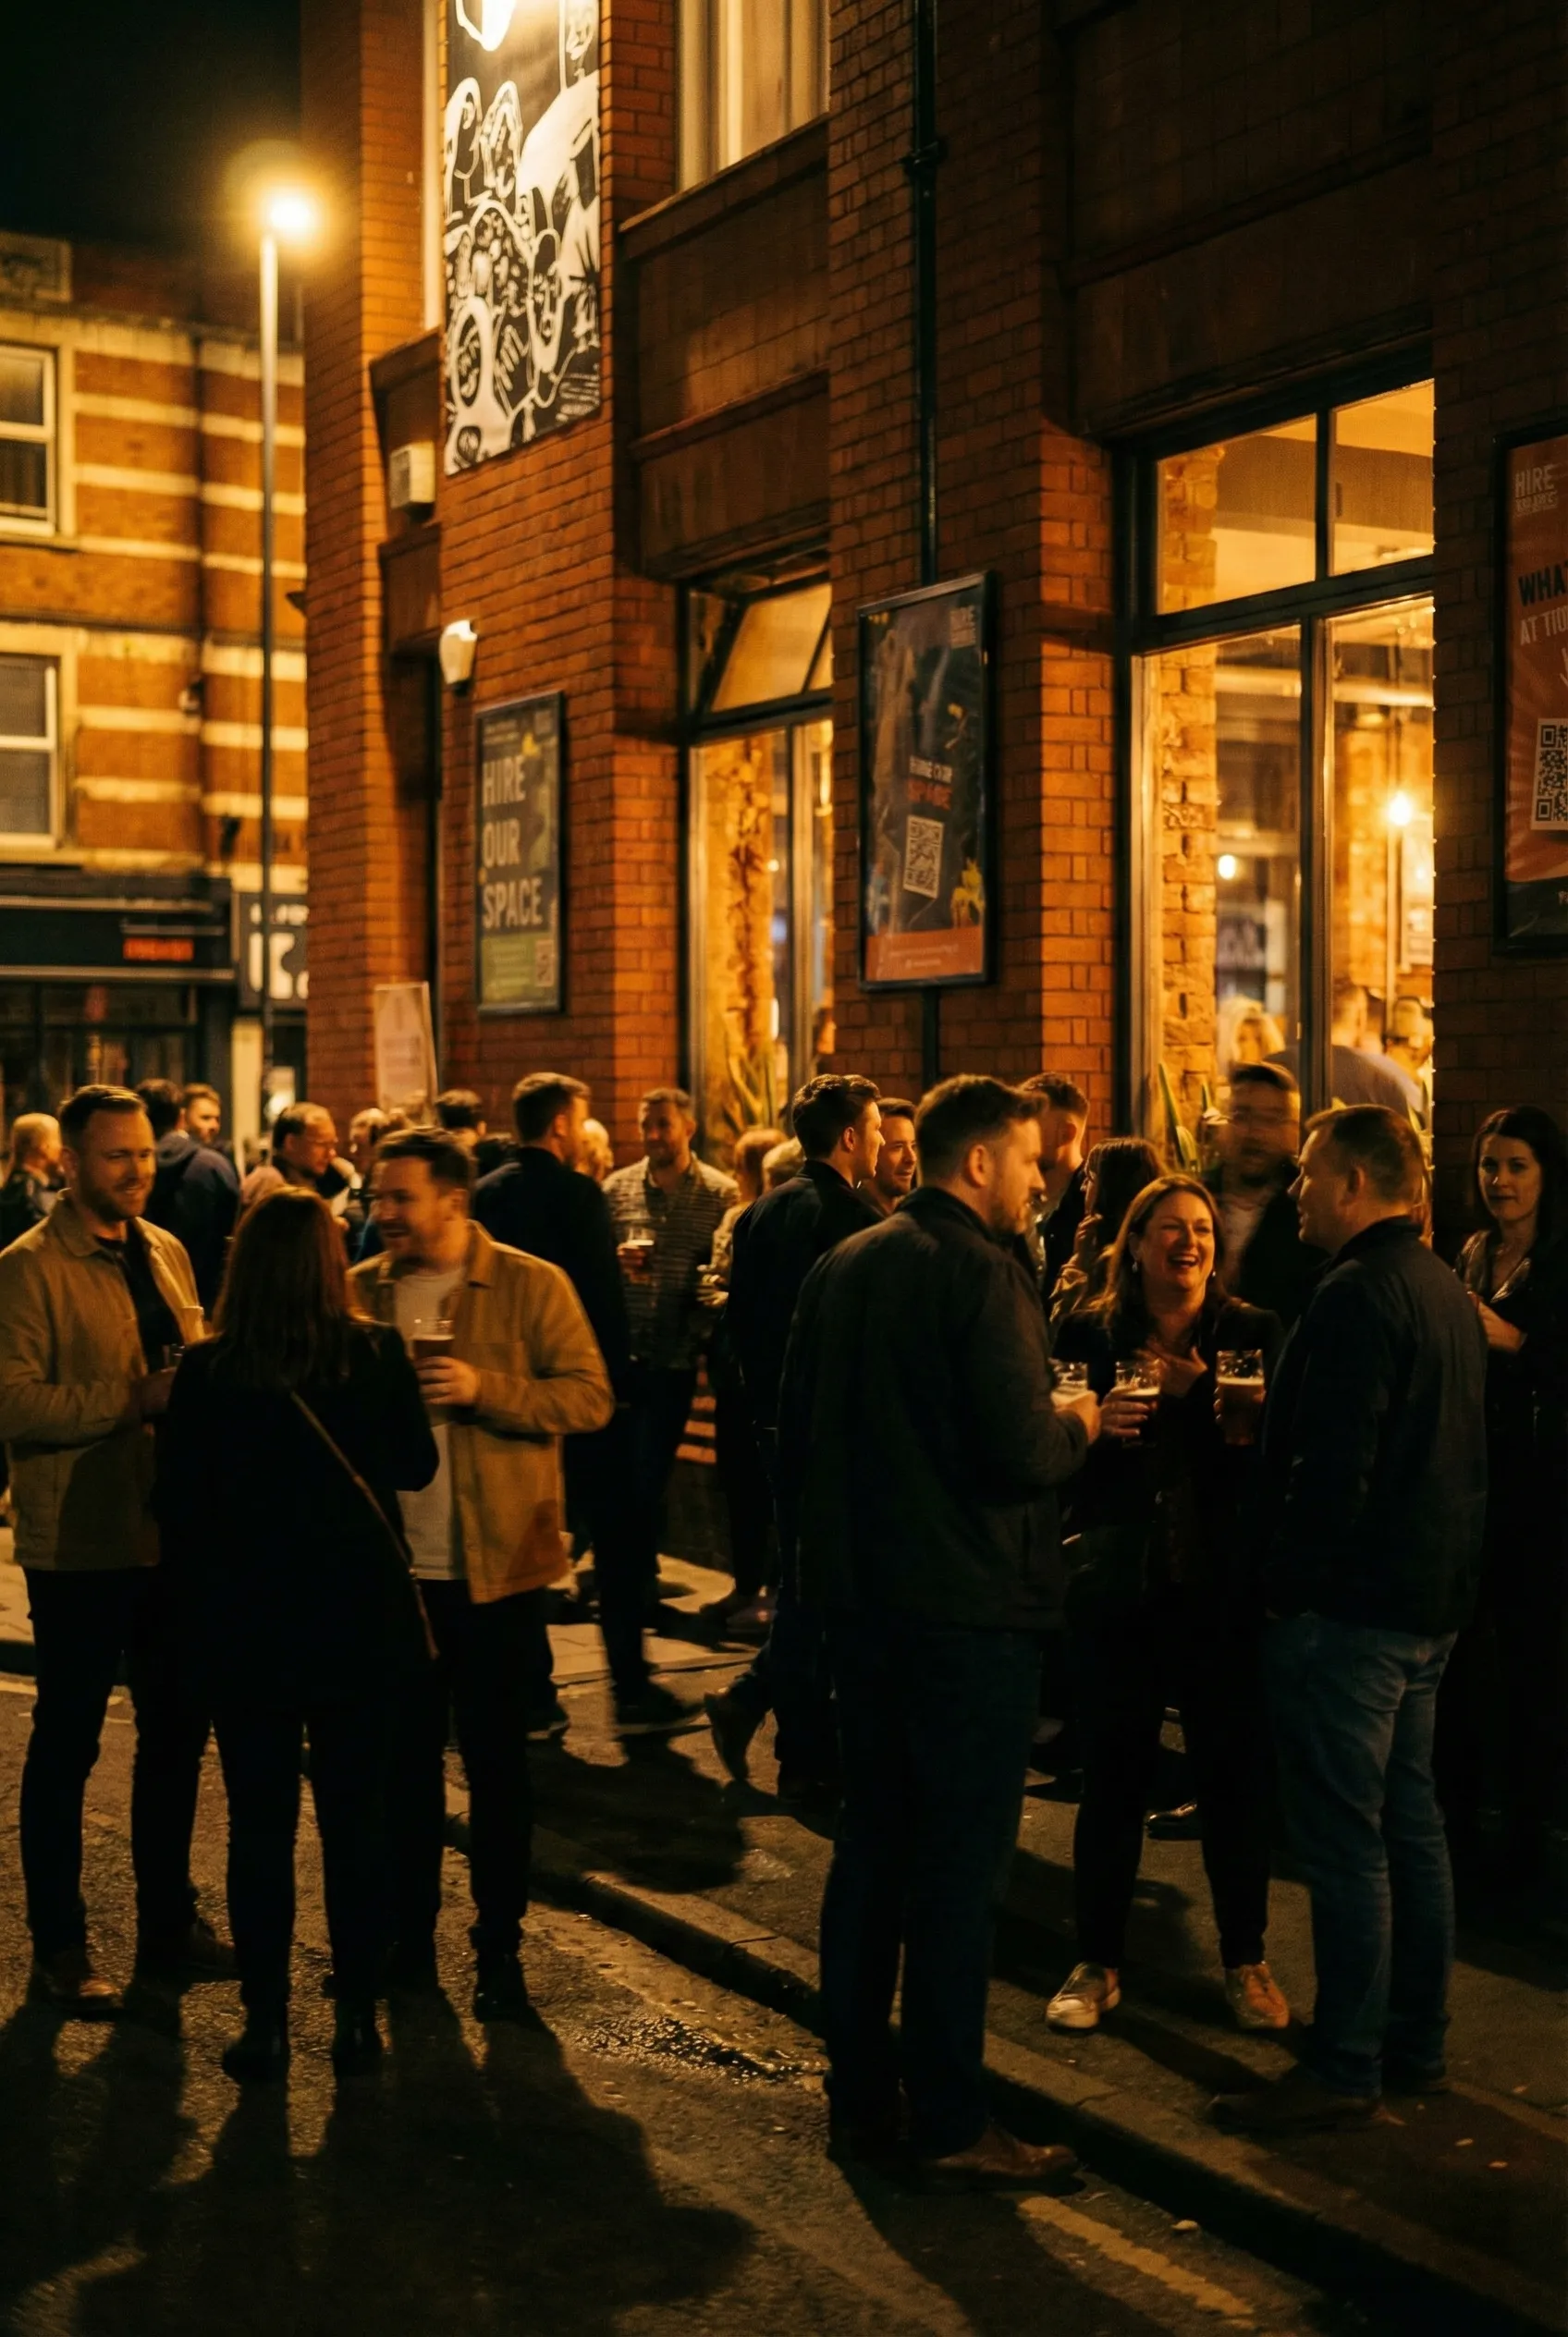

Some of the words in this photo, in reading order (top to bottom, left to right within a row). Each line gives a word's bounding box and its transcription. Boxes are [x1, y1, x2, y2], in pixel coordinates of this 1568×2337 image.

[1515, 465, 1556, 497] HIRE
[1518, 559, 1568, 606] WHA
[1521, 615, 1537, 645] AT
[483, 754, 526, 807] HIRE
[483, 818, 521, 868] OUR
[483, 878, 543, 929] SPACE
